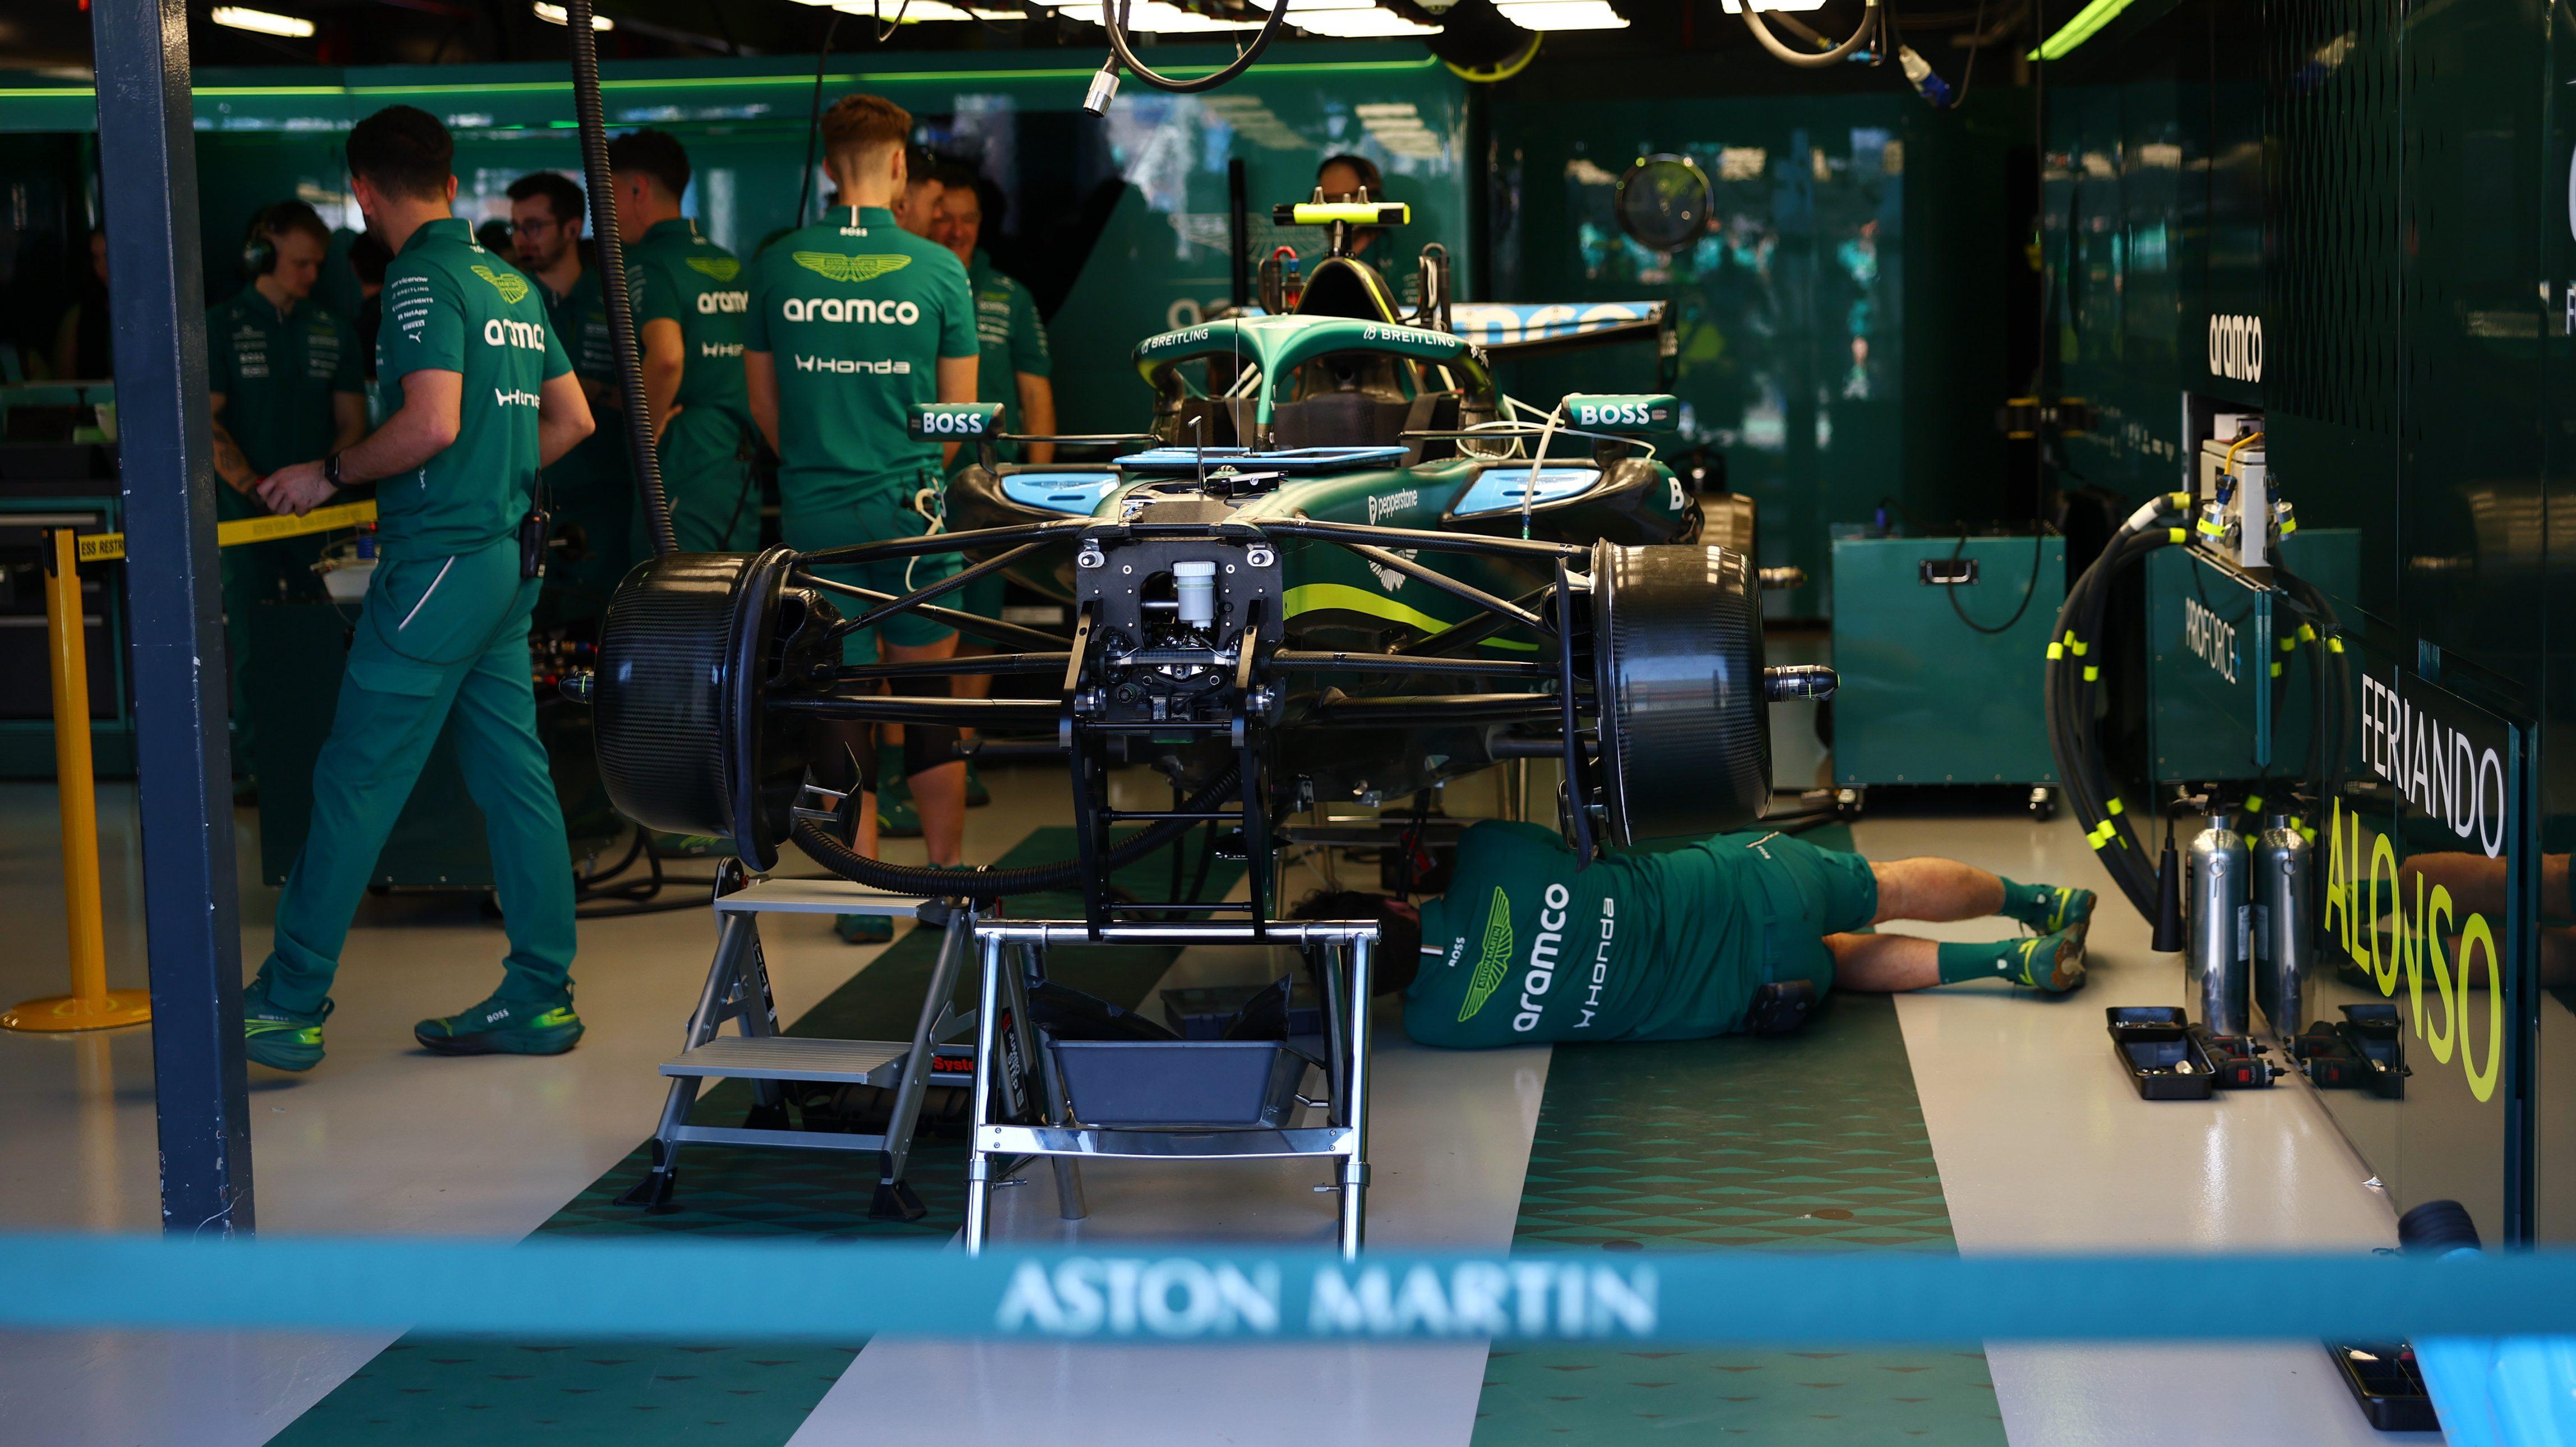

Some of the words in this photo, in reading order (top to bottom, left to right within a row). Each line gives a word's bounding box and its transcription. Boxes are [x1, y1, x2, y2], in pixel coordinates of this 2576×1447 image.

[840, 227, 867, 237] BOSS
[697, 290, 749, 314] aram
[783, 298, 920, 325] aramco
[1151, 328, 1209, 348] BREITLING
[1381, 328, 1455, 347] BREITLING
[2210, 314, 2262, 383] aramco
[816, 357, 911, 374] Honda
[924, 412, 982, 433] BOSS
[1581, 403, 1650, 425] BOSS
[1379, 488, 1418, 520] pepperstone
[99, 538, 123, 555] RESTR
[1480, 959, 1491, 986] ASTON
[1487, 927, 1502, 957] MARTIN
[1513, 883, 1569, 1032] aramco
[1585, 897, 1614, 1005] Honda
[2324, 795, 2501, 1103] ALONSO
[486, 1009, 510, 1023] BOSS
[933, 1056, 974, 1072] Syst
[998, 1259, 1280, 1337] ASTON
[1308, 1260, 1657, 1336] MARTIN
